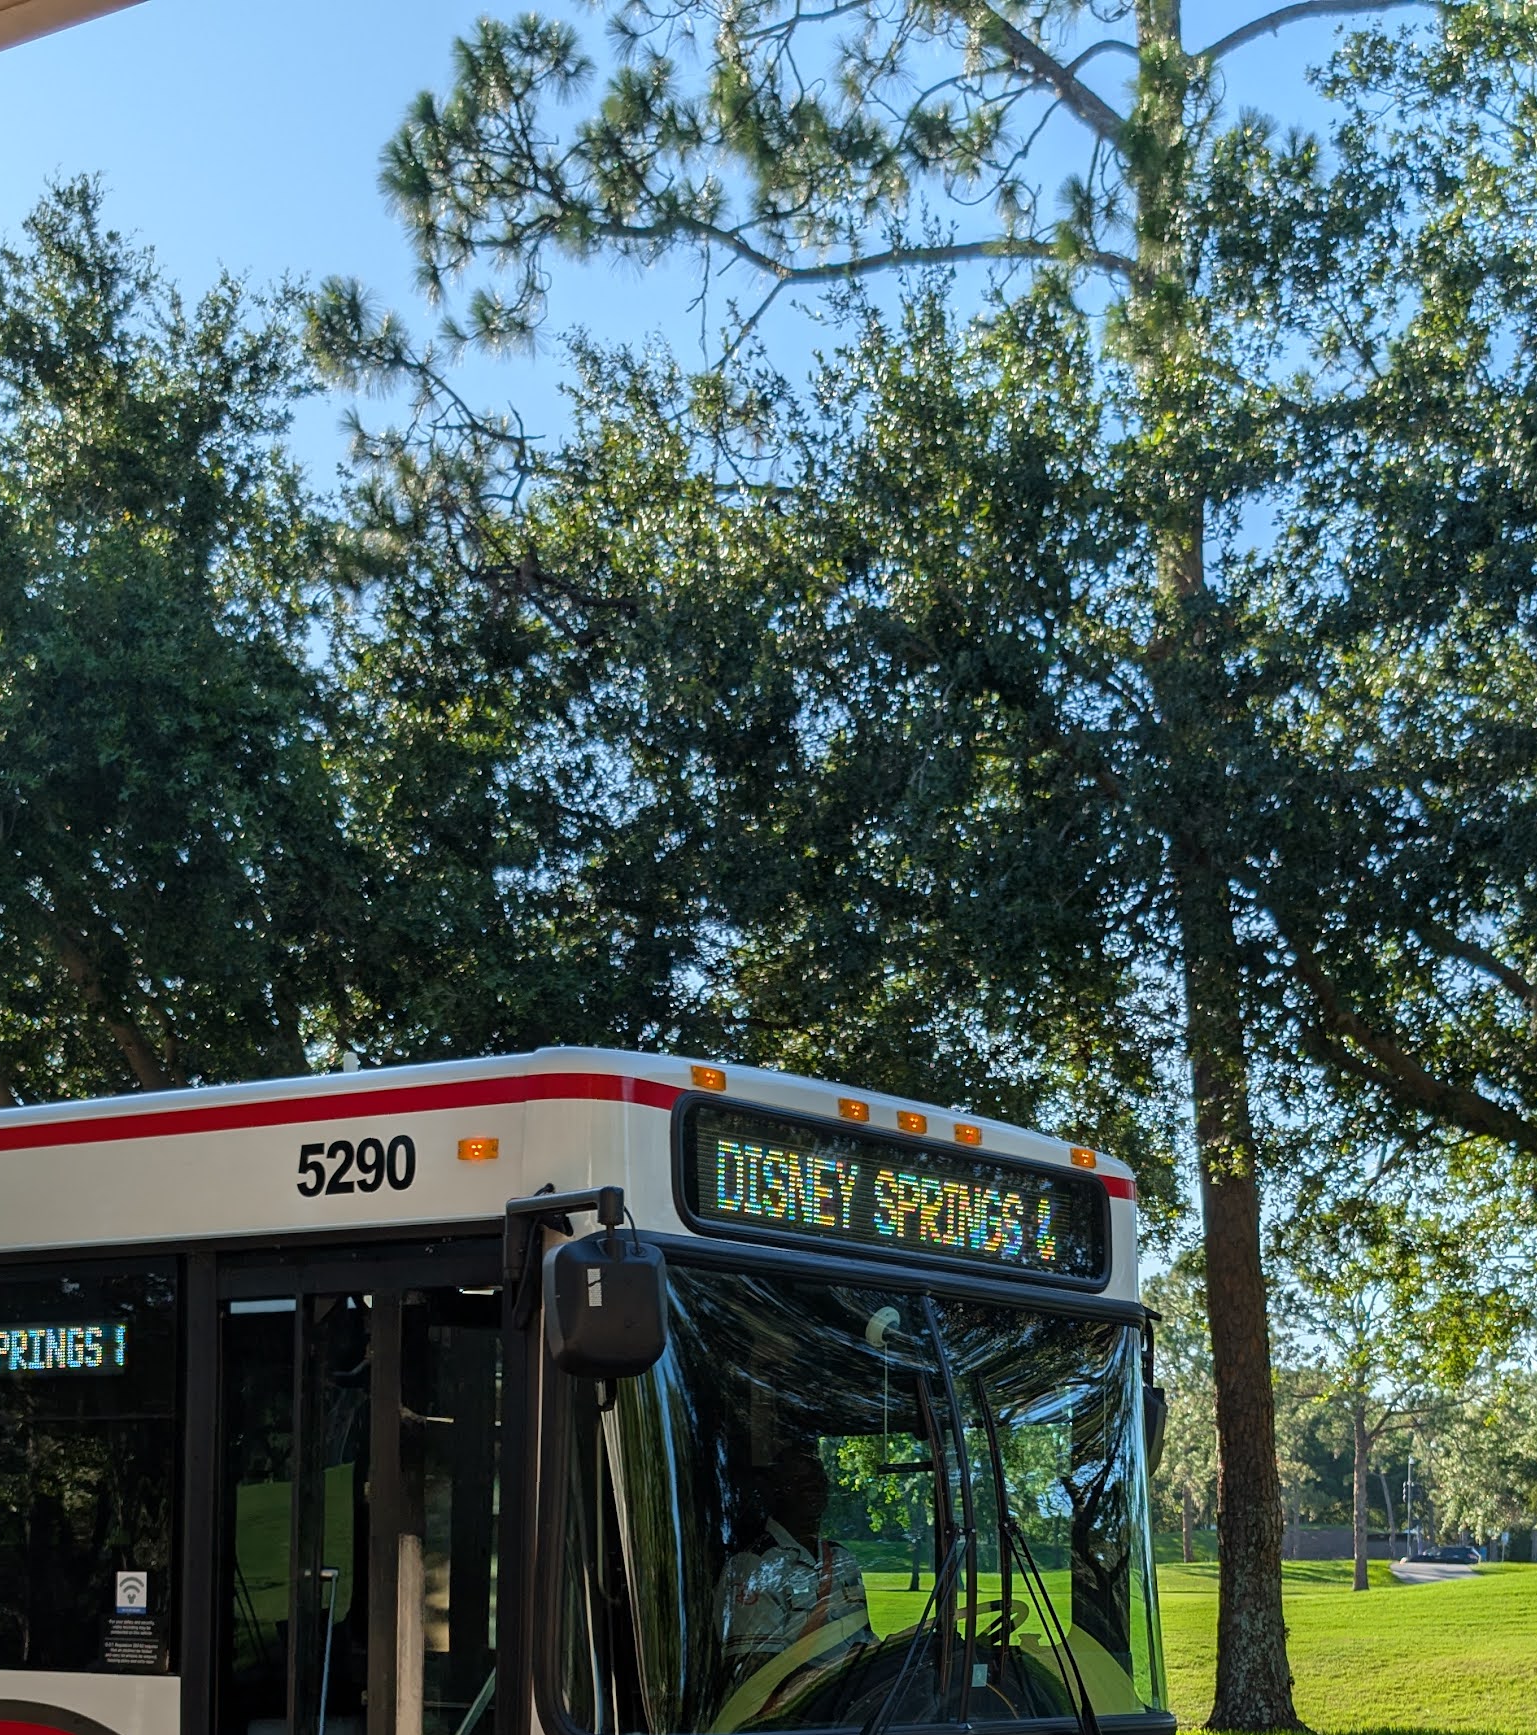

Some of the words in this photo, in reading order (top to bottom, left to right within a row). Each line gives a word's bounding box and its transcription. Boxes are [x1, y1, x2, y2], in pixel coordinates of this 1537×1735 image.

[296, 1134, 417, 1198] 5290
[716, 1139, 859, 1230] DISNEY
[873, 1169, 1024, 1256] SPRINGS
